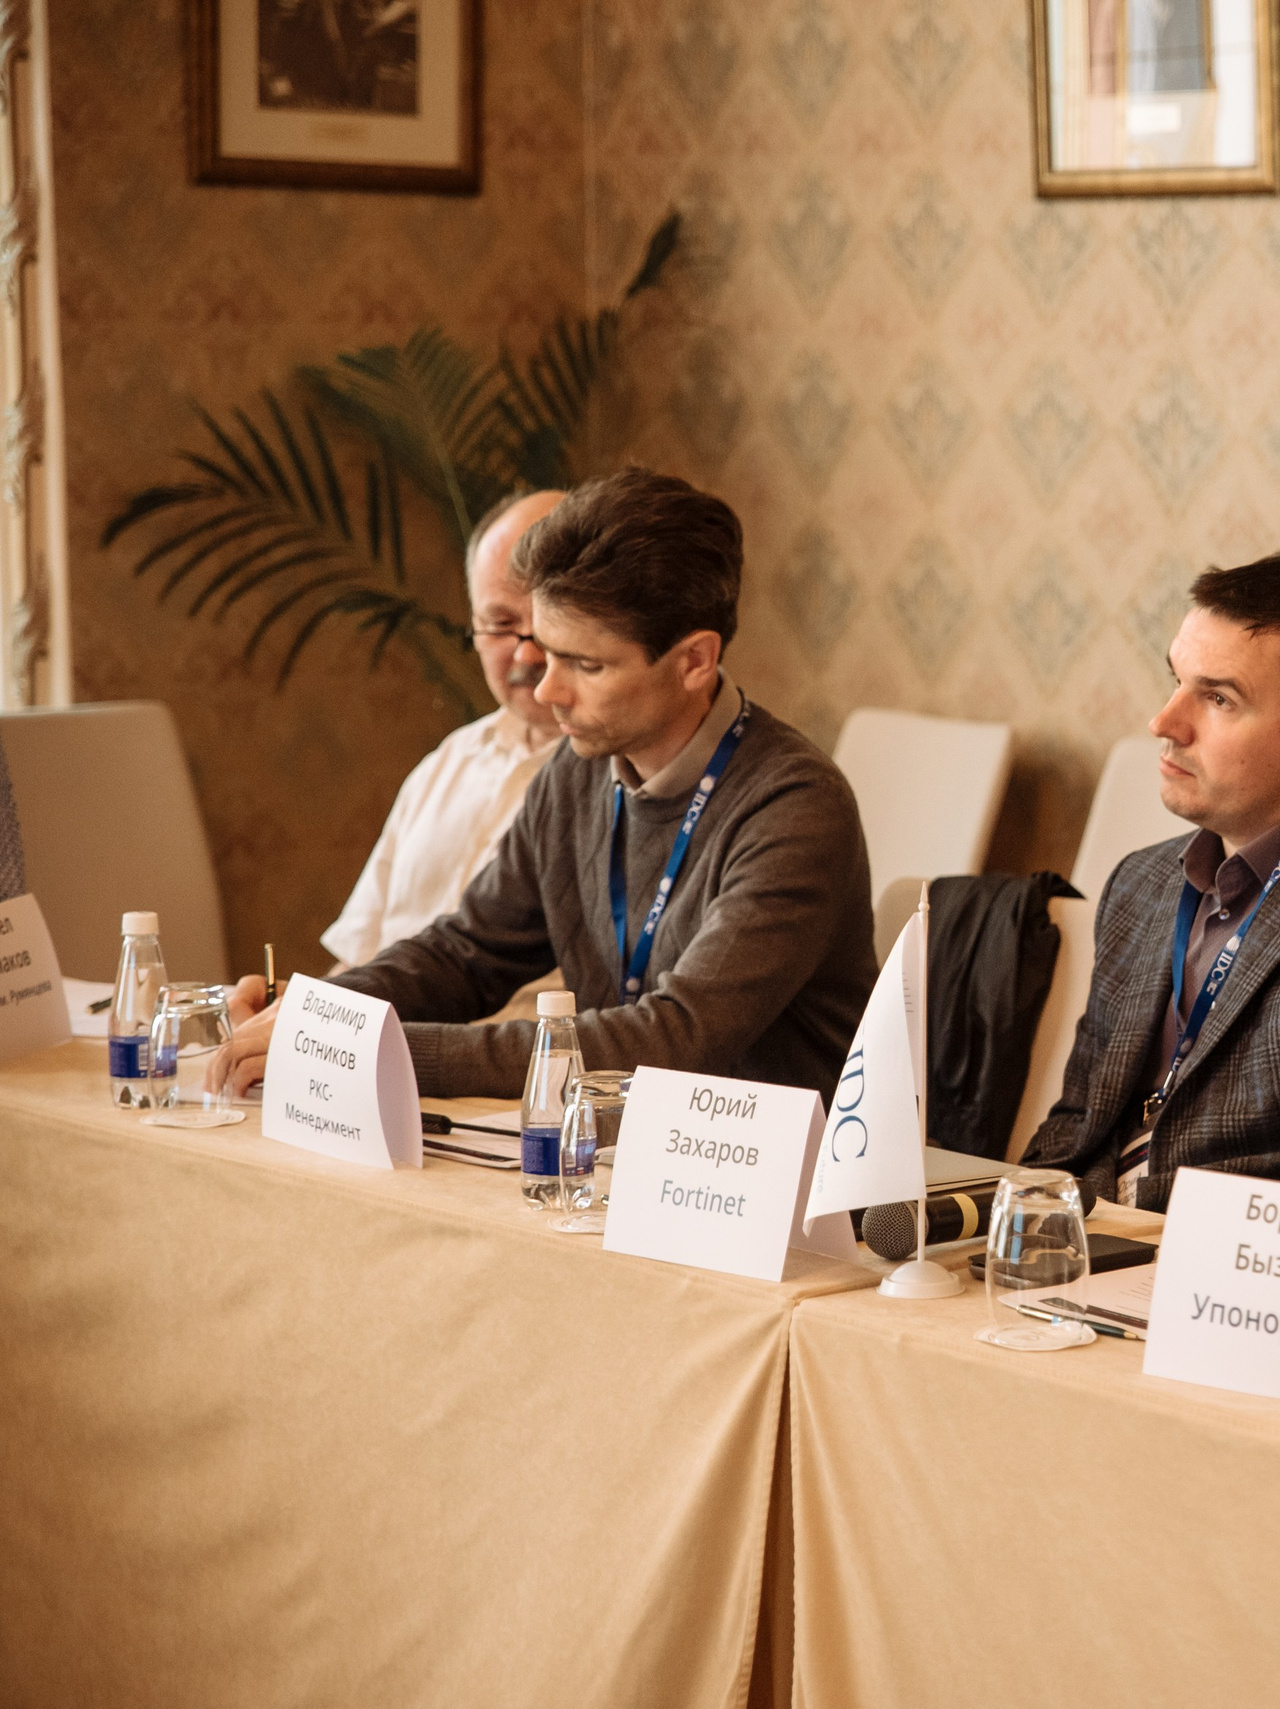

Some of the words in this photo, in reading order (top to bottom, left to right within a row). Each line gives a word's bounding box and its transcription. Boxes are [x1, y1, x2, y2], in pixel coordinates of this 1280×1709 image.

[1211, 952, 1234, 983] IDC
[302, 990, 367, 1036] Владимир
[294, 1030, 356, 1071] Сотников
[309, 1078, 333, 1102] РКС-
[689, 1086, 758, 1122] Юрий
[831, 1043, 869, 1163] IDC
[285, 1102, 361, 1142] Менеджмент
[665, 1129, 760, 1169] Захаров
[660, 1179, 747, 1217] Fortinet
